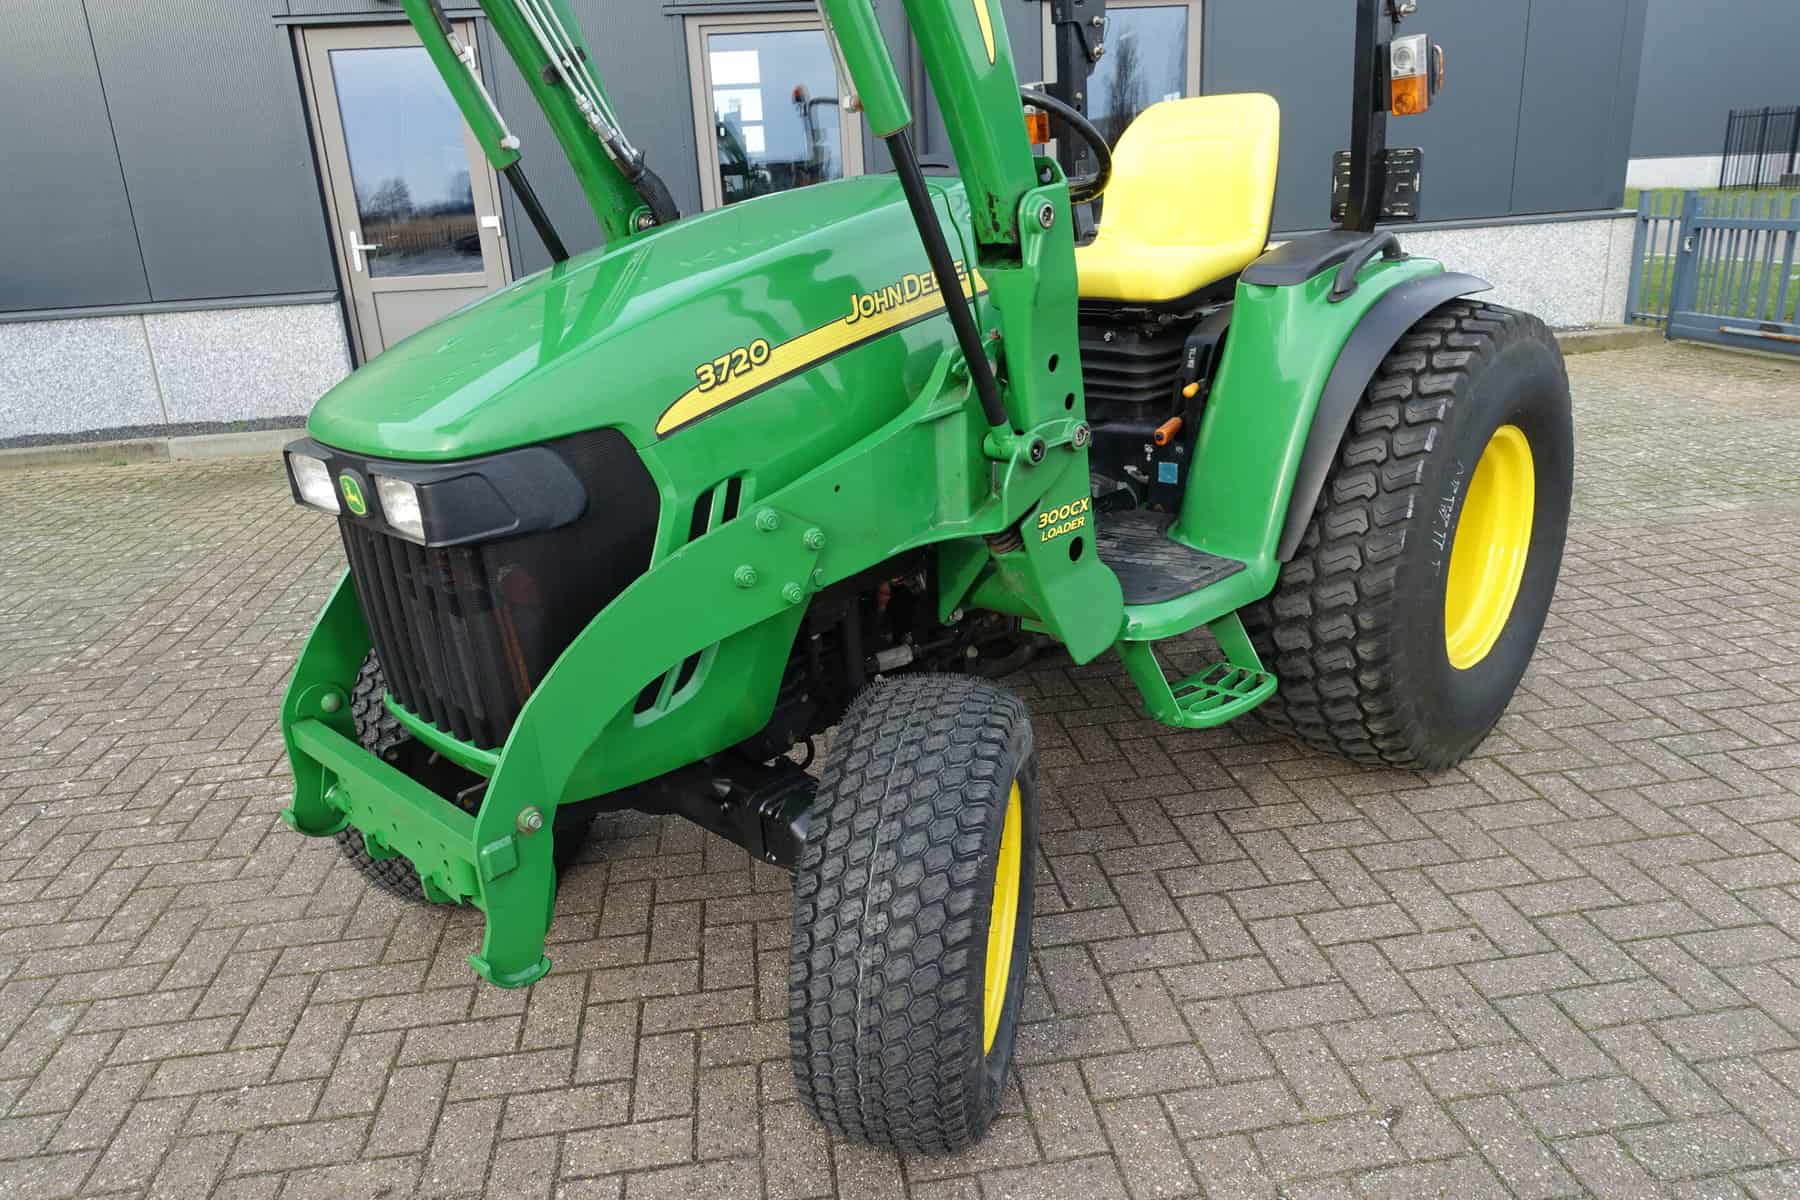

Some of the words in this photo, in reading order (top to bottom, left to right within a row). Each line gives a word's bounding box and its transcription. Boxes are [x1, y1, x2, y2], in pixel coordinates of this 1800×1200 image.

[846, 283, 903, 324] JOHN
[902, 259, 968, 302] DEEE
[696, 338, 770, 392] 3720
[1038, 496, 1089, 529] 300CX
[1041, 516, 1085, 543] LOADER
